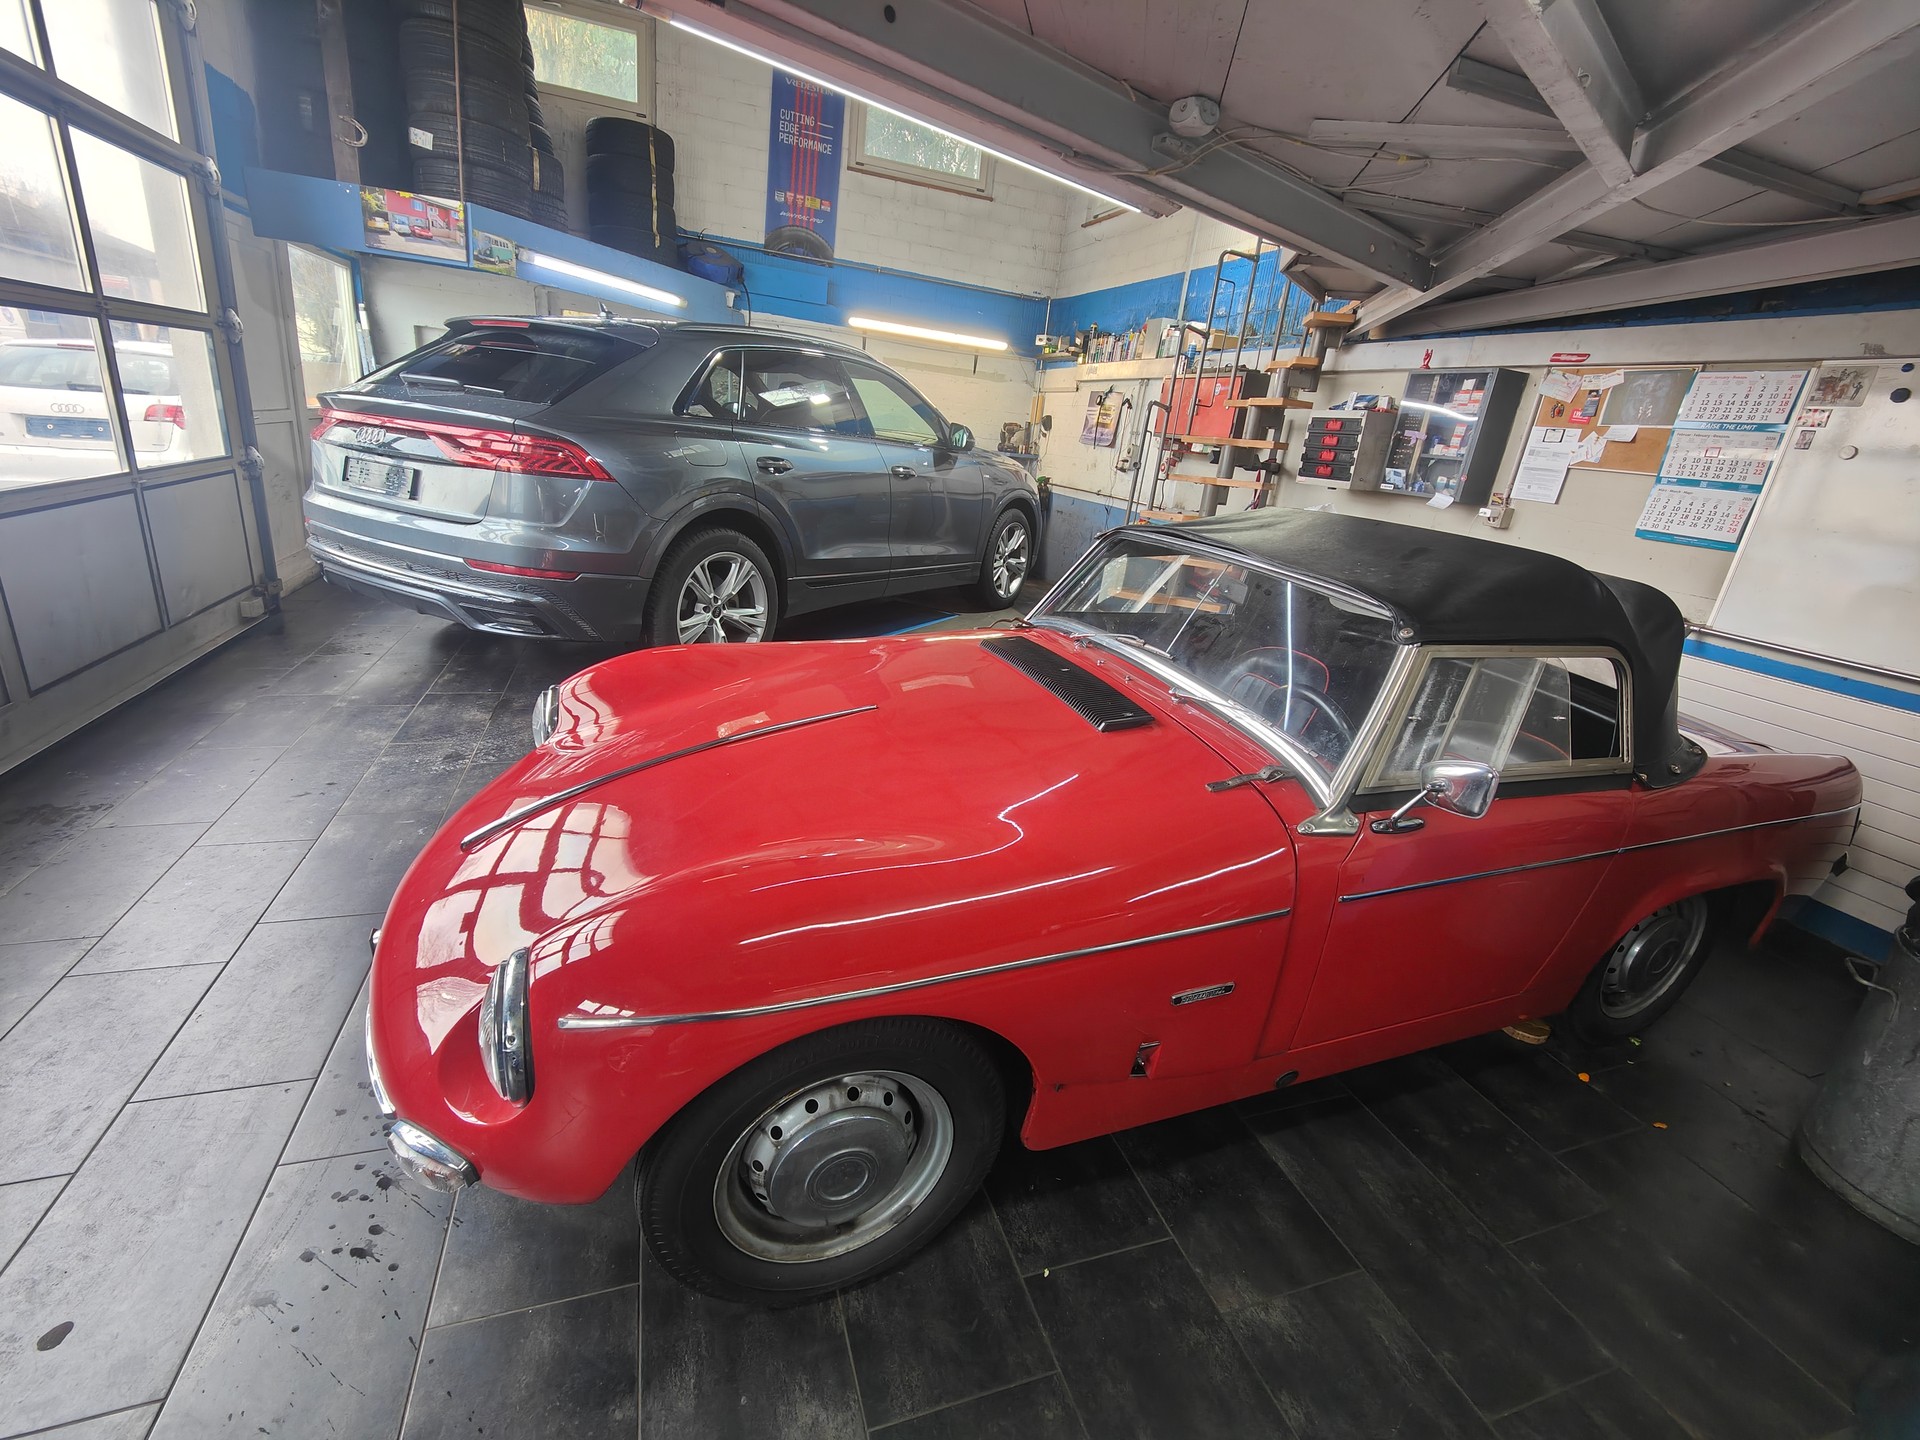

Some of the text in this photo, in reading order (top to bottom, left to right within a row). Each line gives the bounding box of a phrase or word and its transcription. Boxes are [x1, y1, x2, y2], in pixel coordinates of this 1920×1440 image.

[785, 76, 834, 96] VREDESTEIN
[780, 108, 815, 127] CUTTING
[779, 120, 800, 135] EDGE
[778, 132, 833, 155] PERFORMANCE
